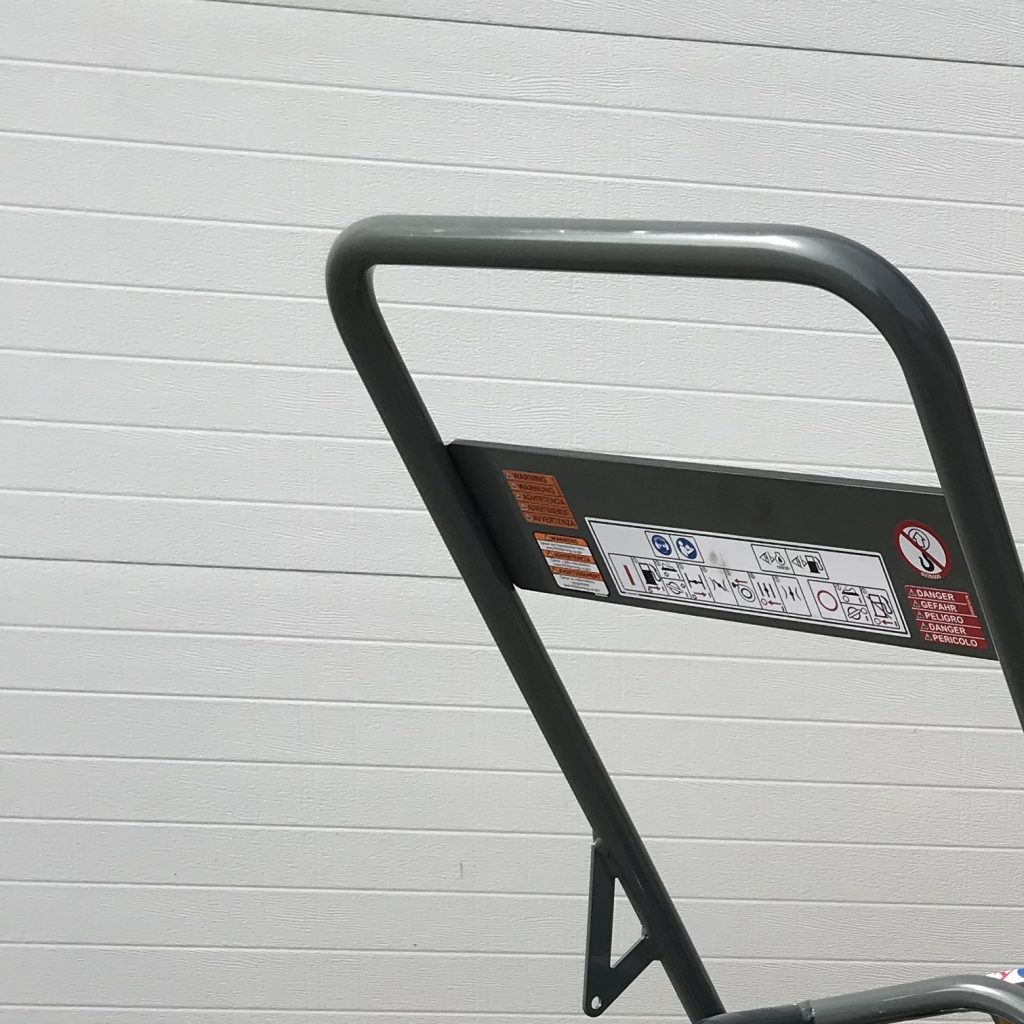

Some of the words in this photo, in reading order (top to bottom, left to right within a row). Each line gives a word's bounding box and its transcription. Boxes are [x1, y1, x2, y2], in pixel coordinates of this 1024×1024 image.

[511, 472, 547, 483] WARNING
[916, 589, 955, 601] DANGER
[920, 600, 958, 612] GEFAHR
[924, 611, 964, 624] PELIGRO
[928, 622, 967, 635] DANGER
[932, 633, 978, 647] PERICOLO
